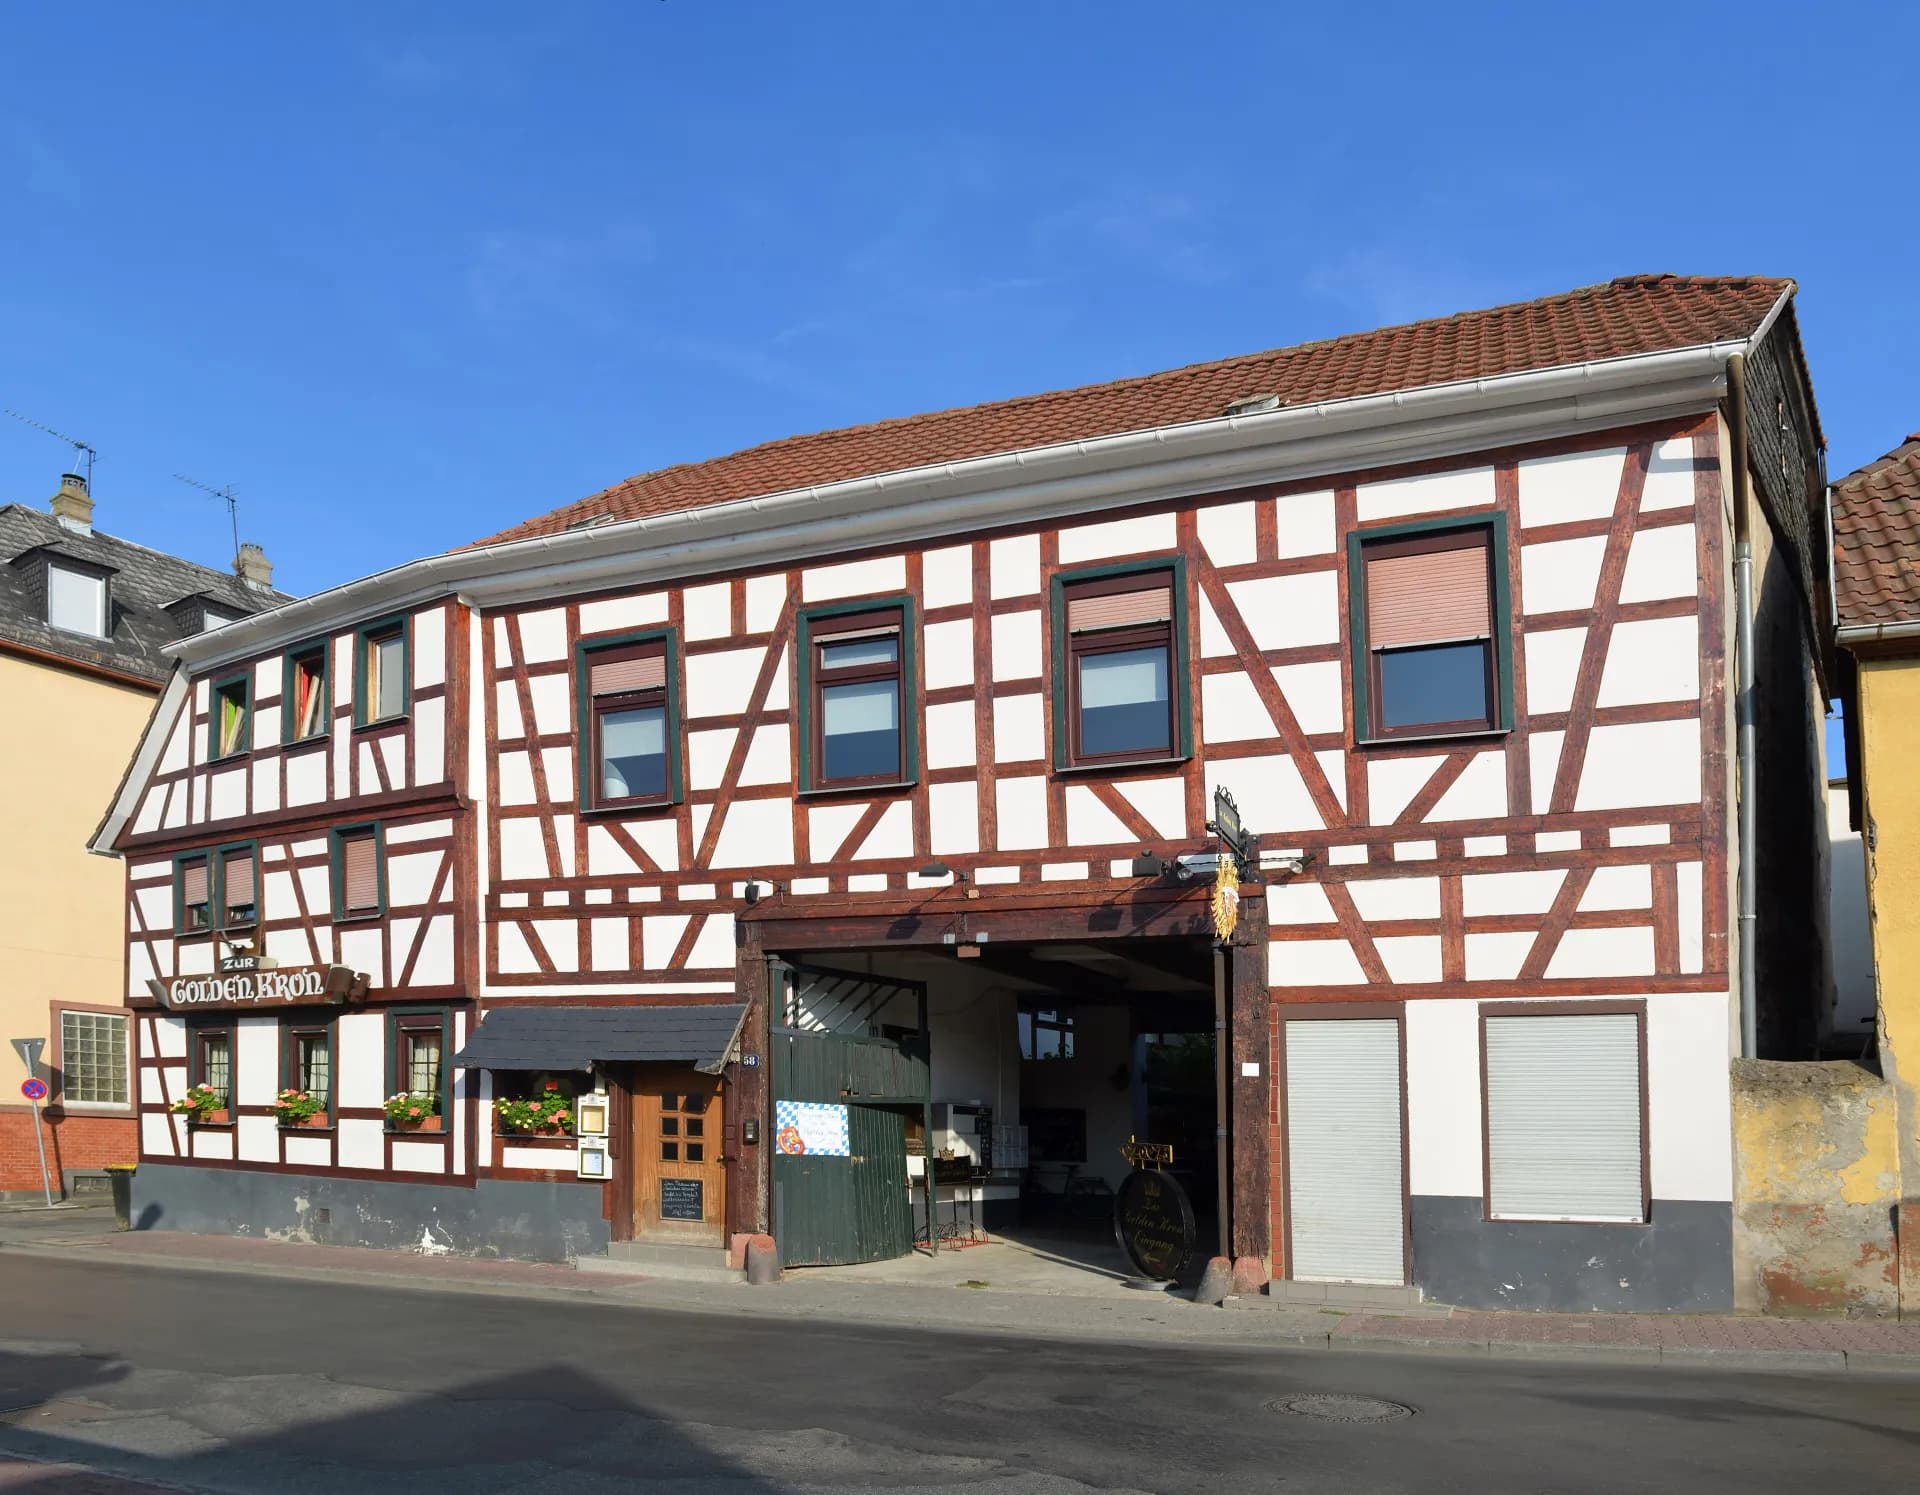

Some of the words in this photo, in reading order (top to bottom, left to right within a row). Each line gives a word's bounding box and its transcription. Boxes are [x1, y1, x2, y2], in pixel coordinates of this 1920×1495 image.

[223, 956, 255, 971] ZUR
[170, 973, 255, 1004] GOLDEN
[254, 968, 324, 1002] KRON
[743, 1056, 756, 1066] 58
